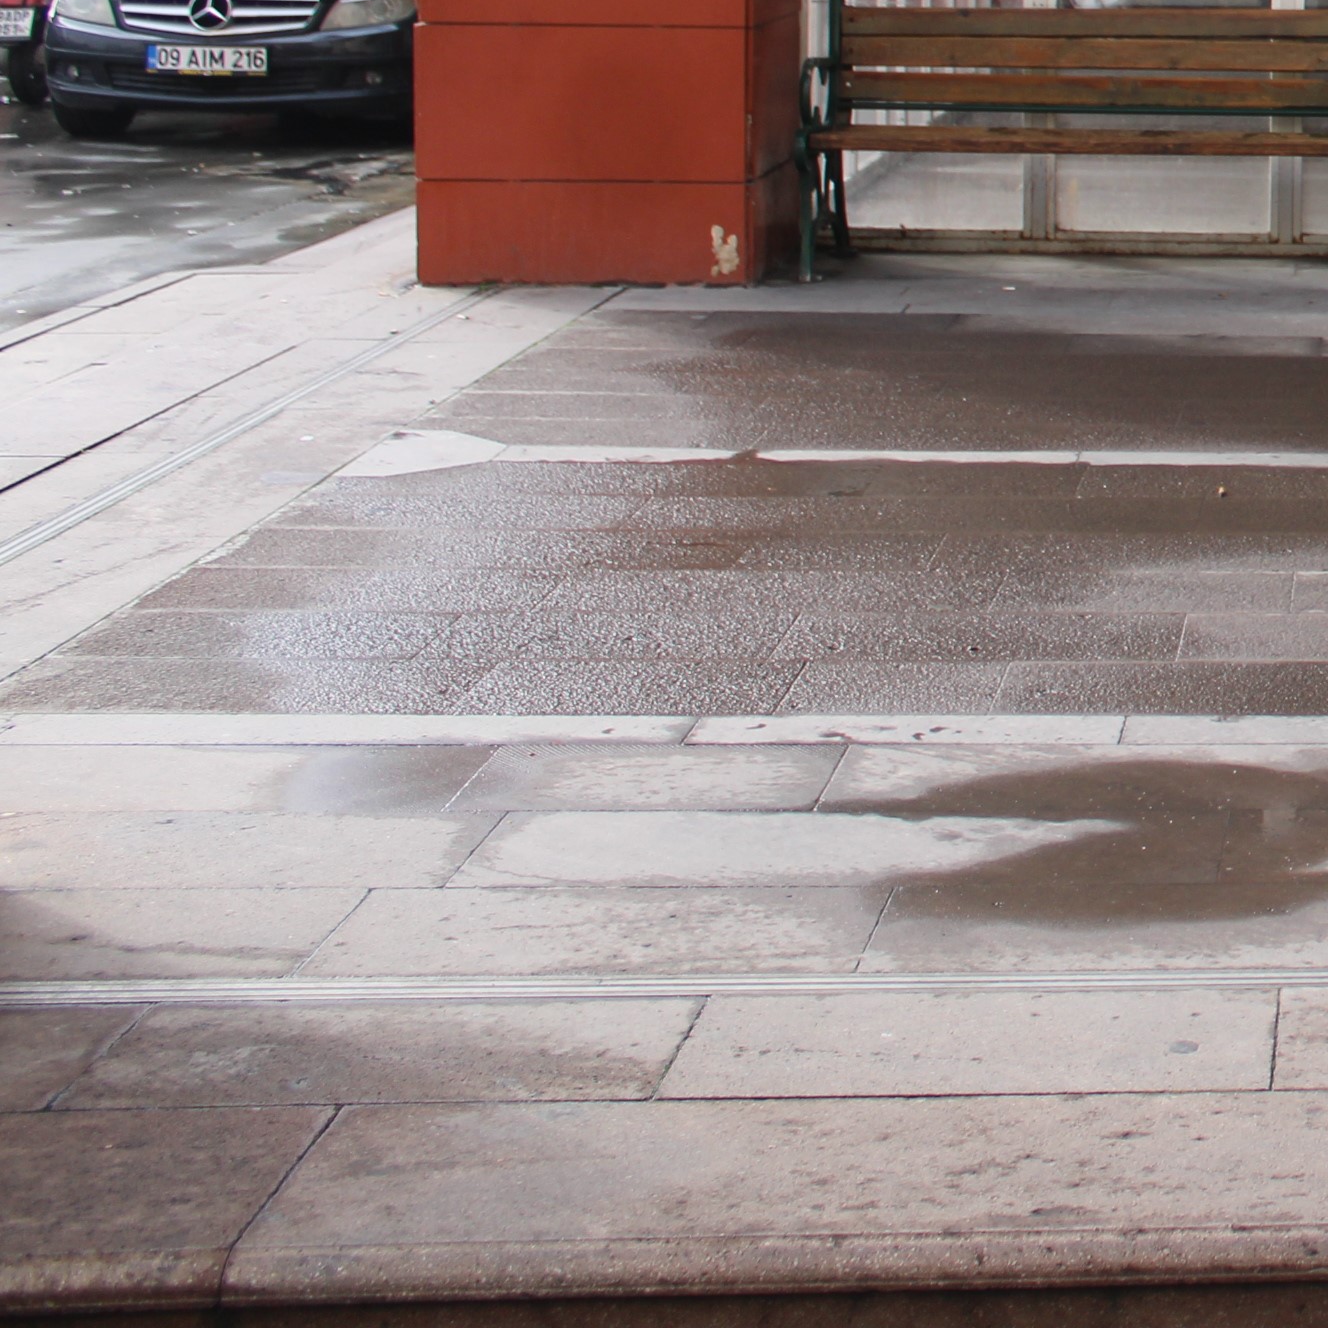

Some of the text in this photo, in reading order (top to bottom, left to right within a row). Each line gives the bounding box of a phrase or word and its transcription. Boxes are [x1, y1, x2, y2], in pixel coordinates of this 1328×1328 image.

[158, 48, 265, 69] 09 AIM 216
